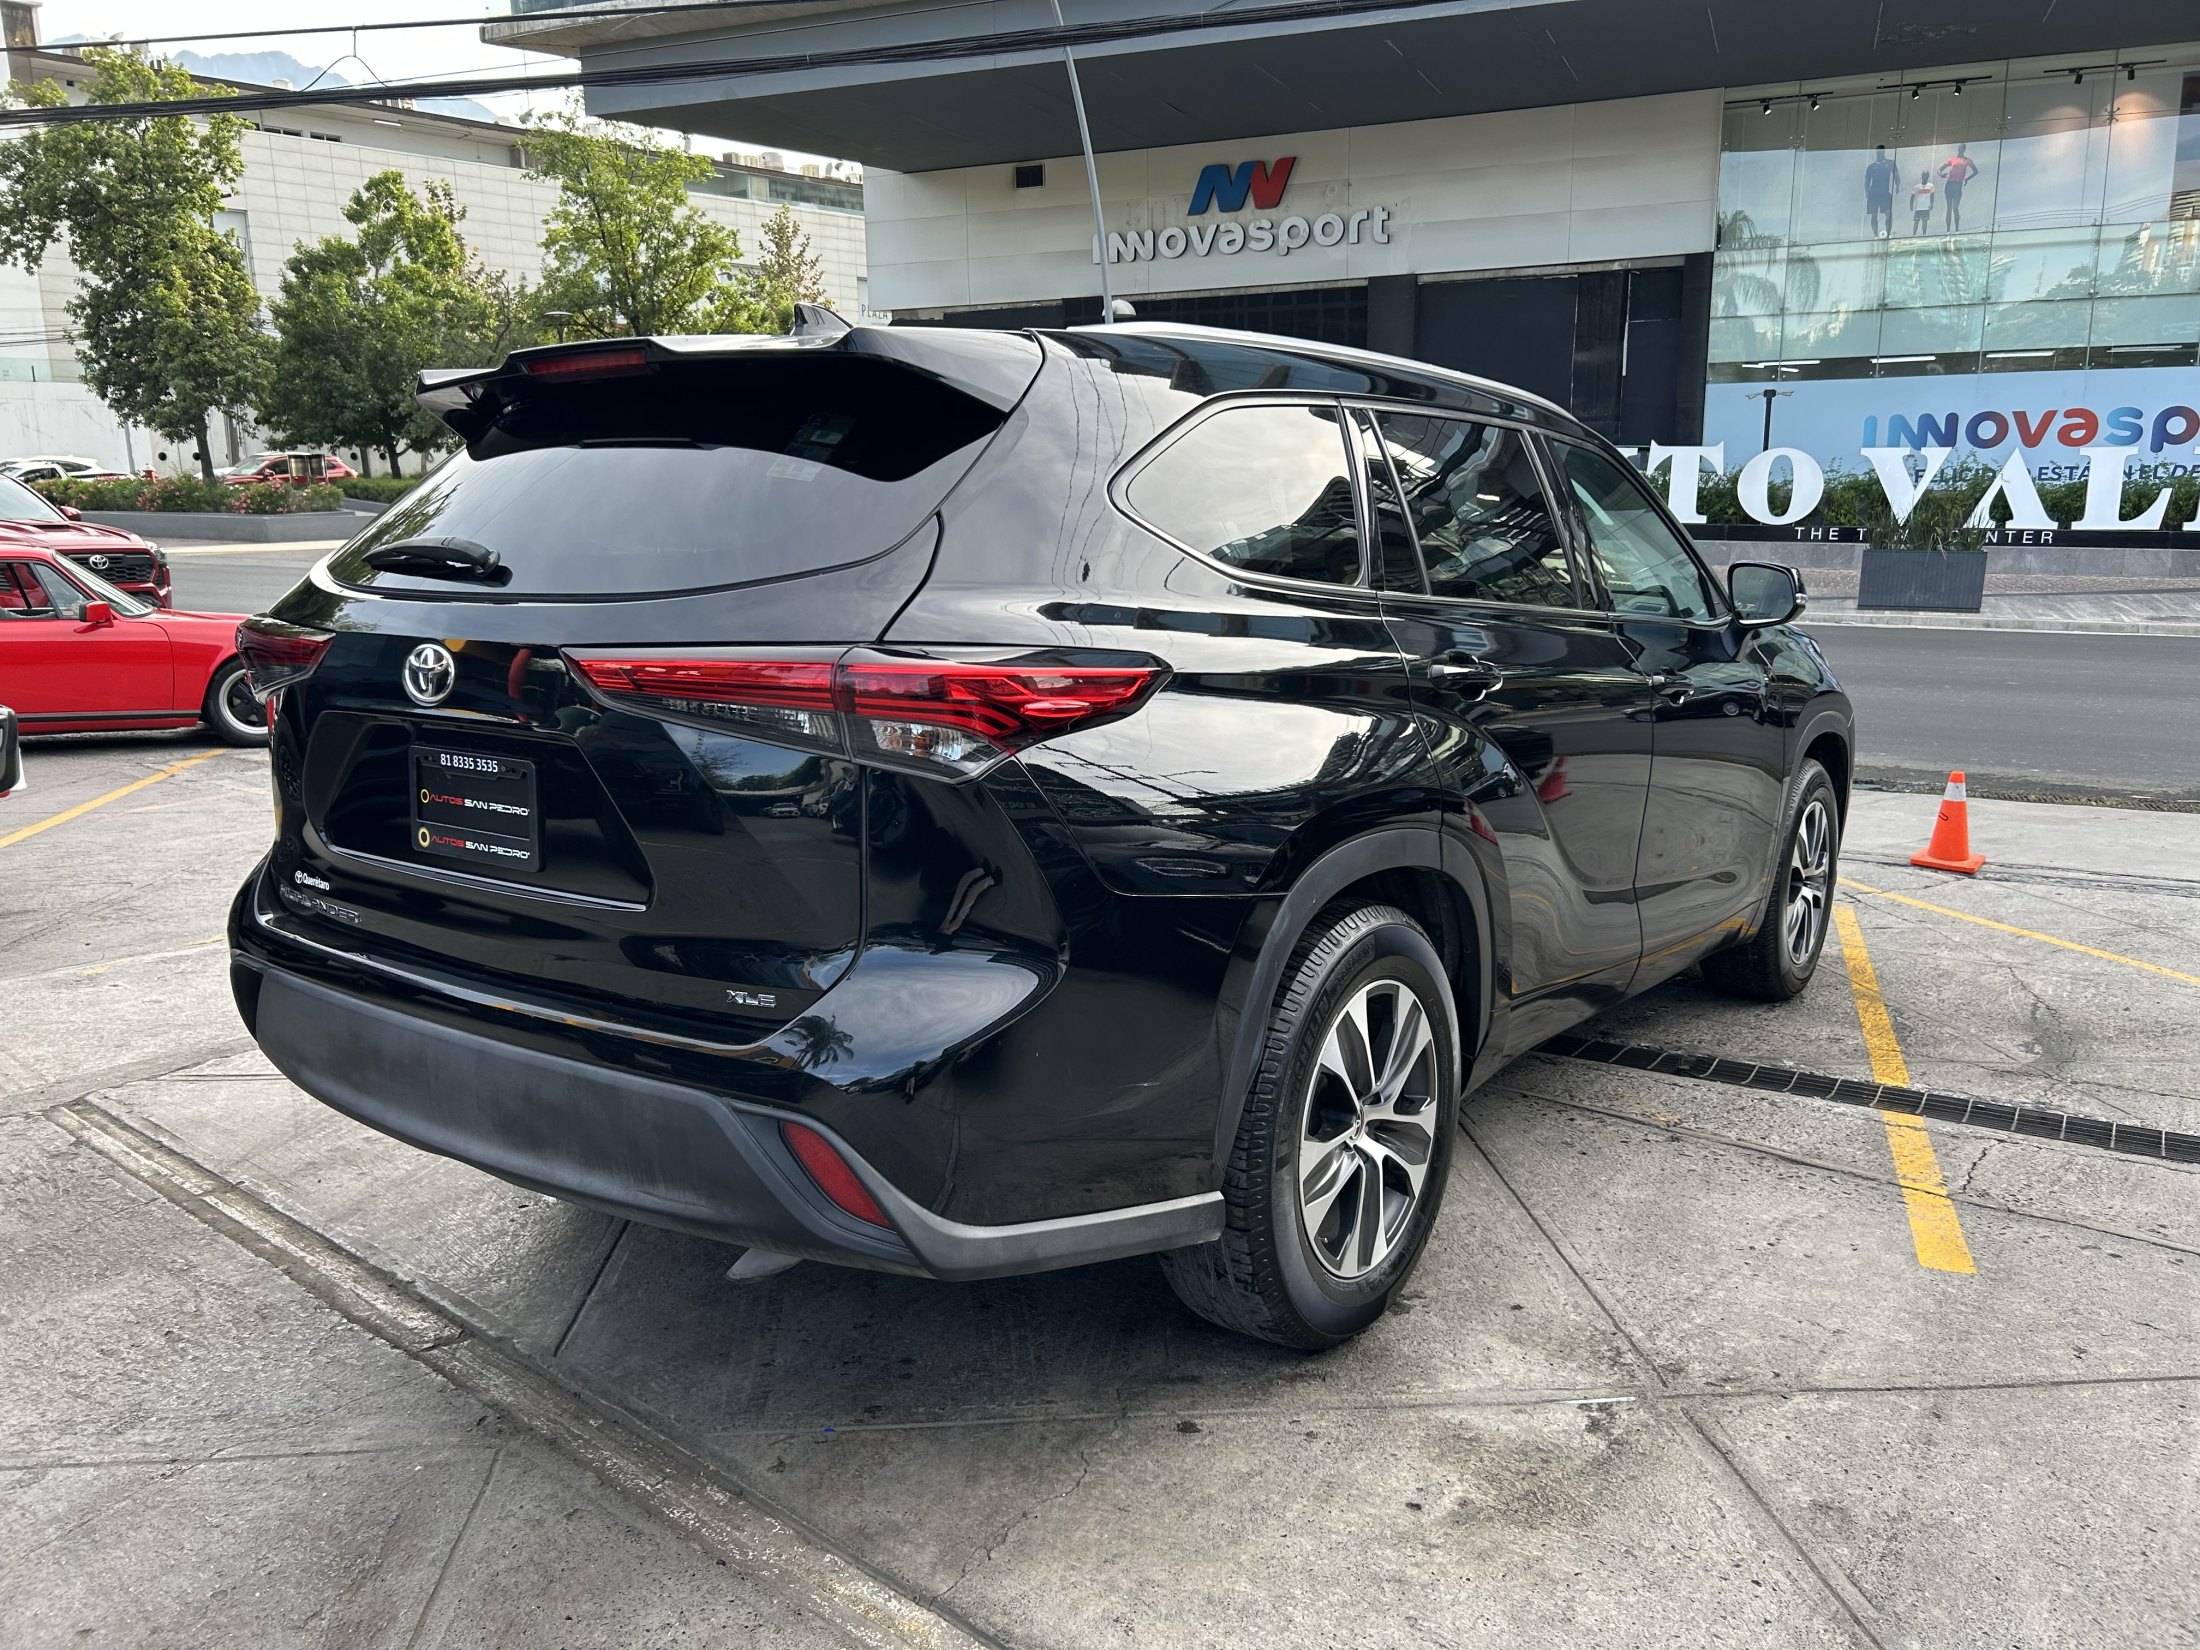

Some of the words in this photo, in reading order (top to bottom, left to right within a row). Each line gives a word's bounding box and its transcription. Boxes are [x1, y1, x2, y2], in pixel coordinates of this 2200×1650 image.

[1794, 526, 1840, 541] THE
[440, 753, 452, 766] 81
[453, 755, 475, 770] 8335
[476, 758, 499, 773] 3535
[429, 793, 464, 806] AUTOS
[464, 798, 488, 810] SAN
[489, 802, 530, 816] PEDRO
[431, 835, 465, 848] AUTOS
[465, 841, 489, 853] SAN
[489, 845, 531, 860] PEDRO
[726, 989, 776, 1008] XLE
